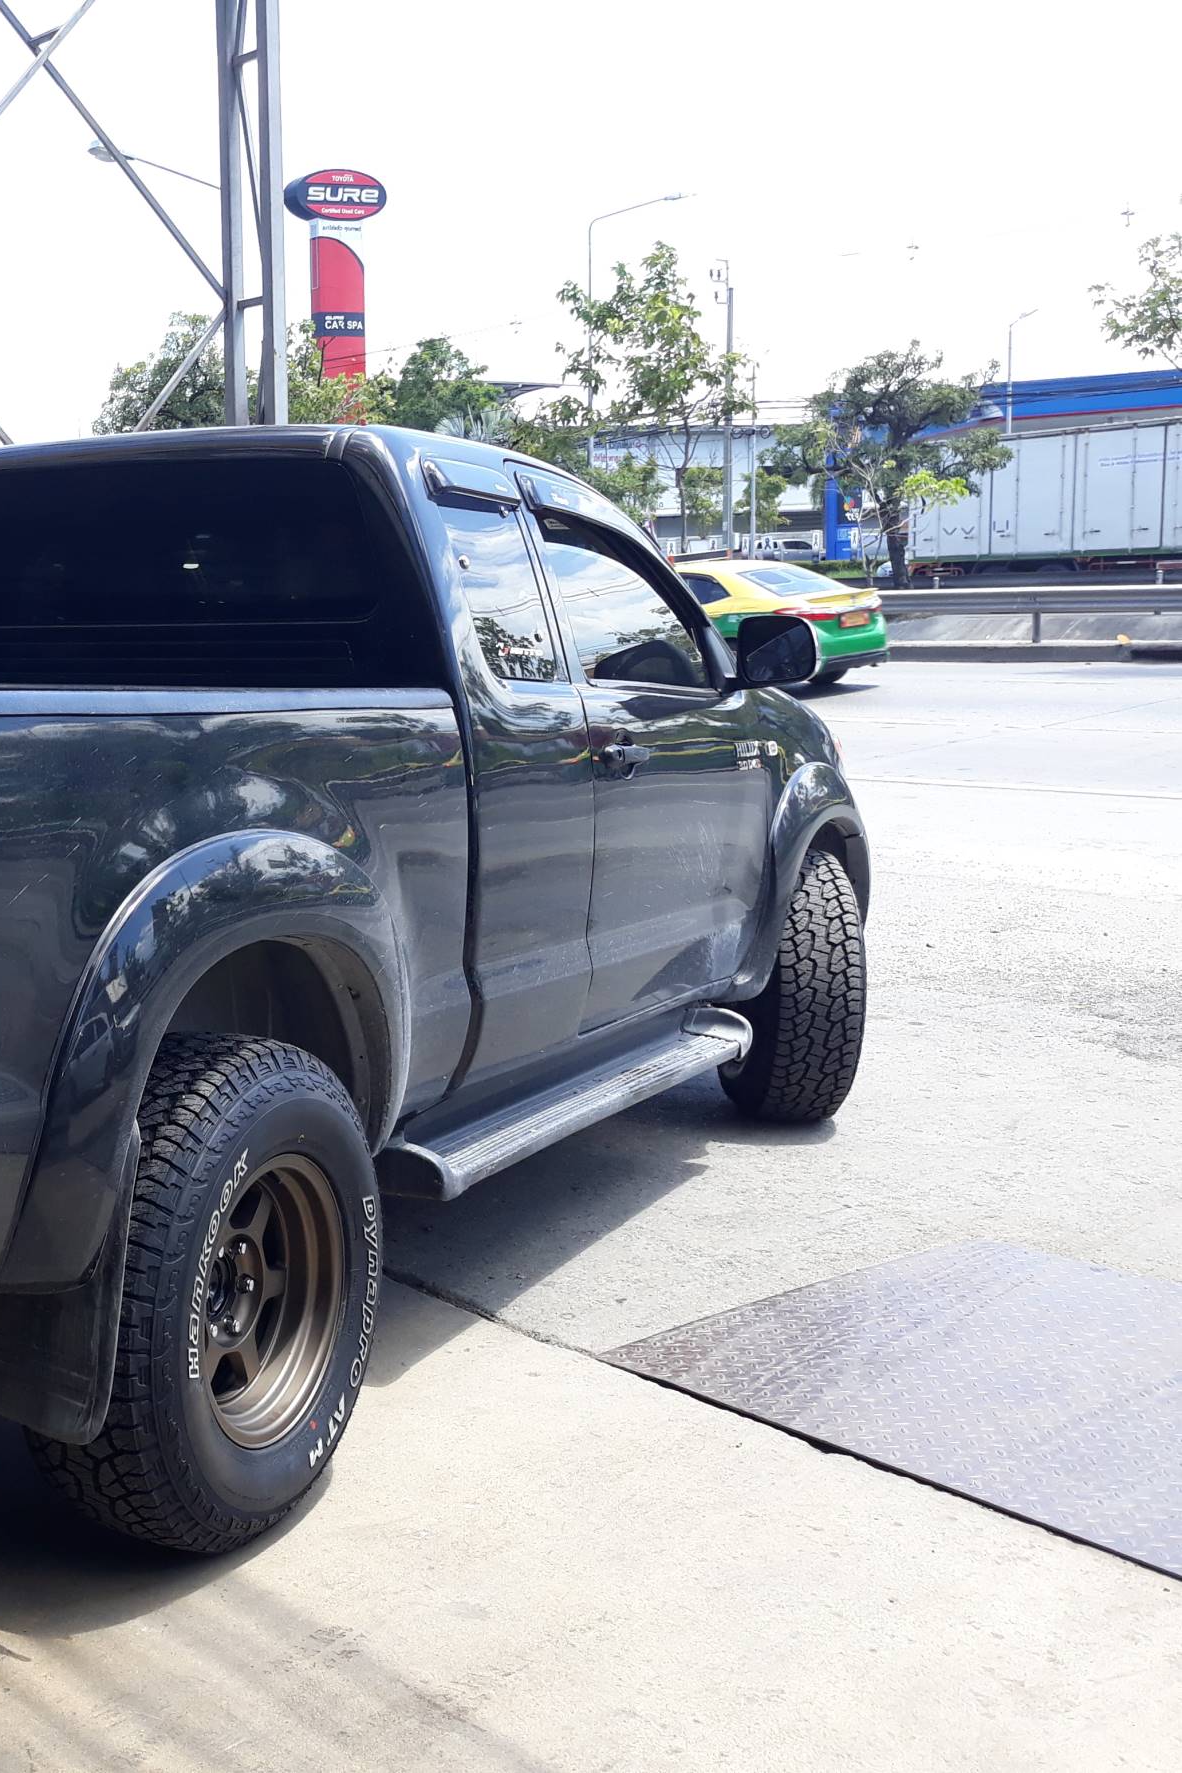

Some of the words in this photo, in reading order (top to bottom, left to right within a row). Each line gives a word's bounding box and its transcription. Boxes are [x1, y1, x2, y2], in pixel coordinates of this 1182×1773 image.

[307, 186, 379, 203] SURE
[325, 320, 344, 330] CAR
[347, 320, 363, 330] SPA
